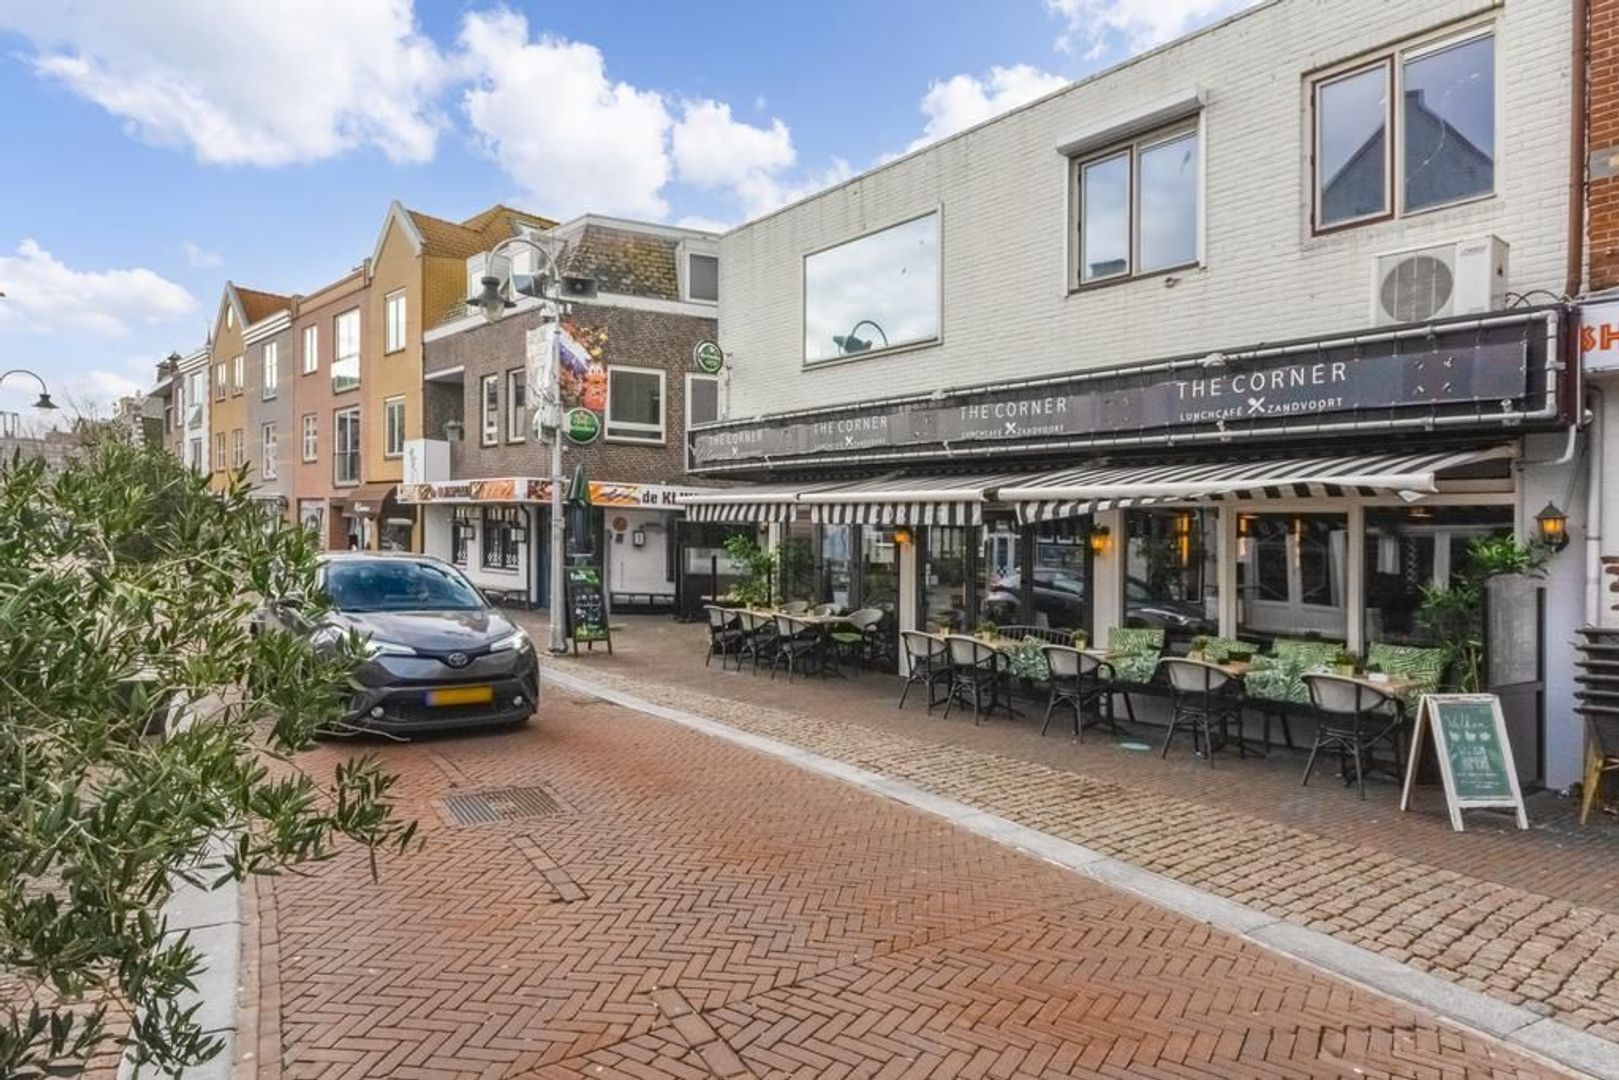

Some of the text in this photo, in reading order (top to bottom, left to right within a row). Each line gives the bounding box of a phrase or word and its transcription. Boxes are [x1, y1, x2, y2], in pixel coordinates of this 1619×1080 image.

[1176, 361, 1347, 399] THE CORNER
[960, 397, 1067, 420] THE CORNER
[1267, 397, 1343, 414] ZANDVOORT
[813, 415, 888, 435] THE CORNER
[642, 490, 658, 504] de
